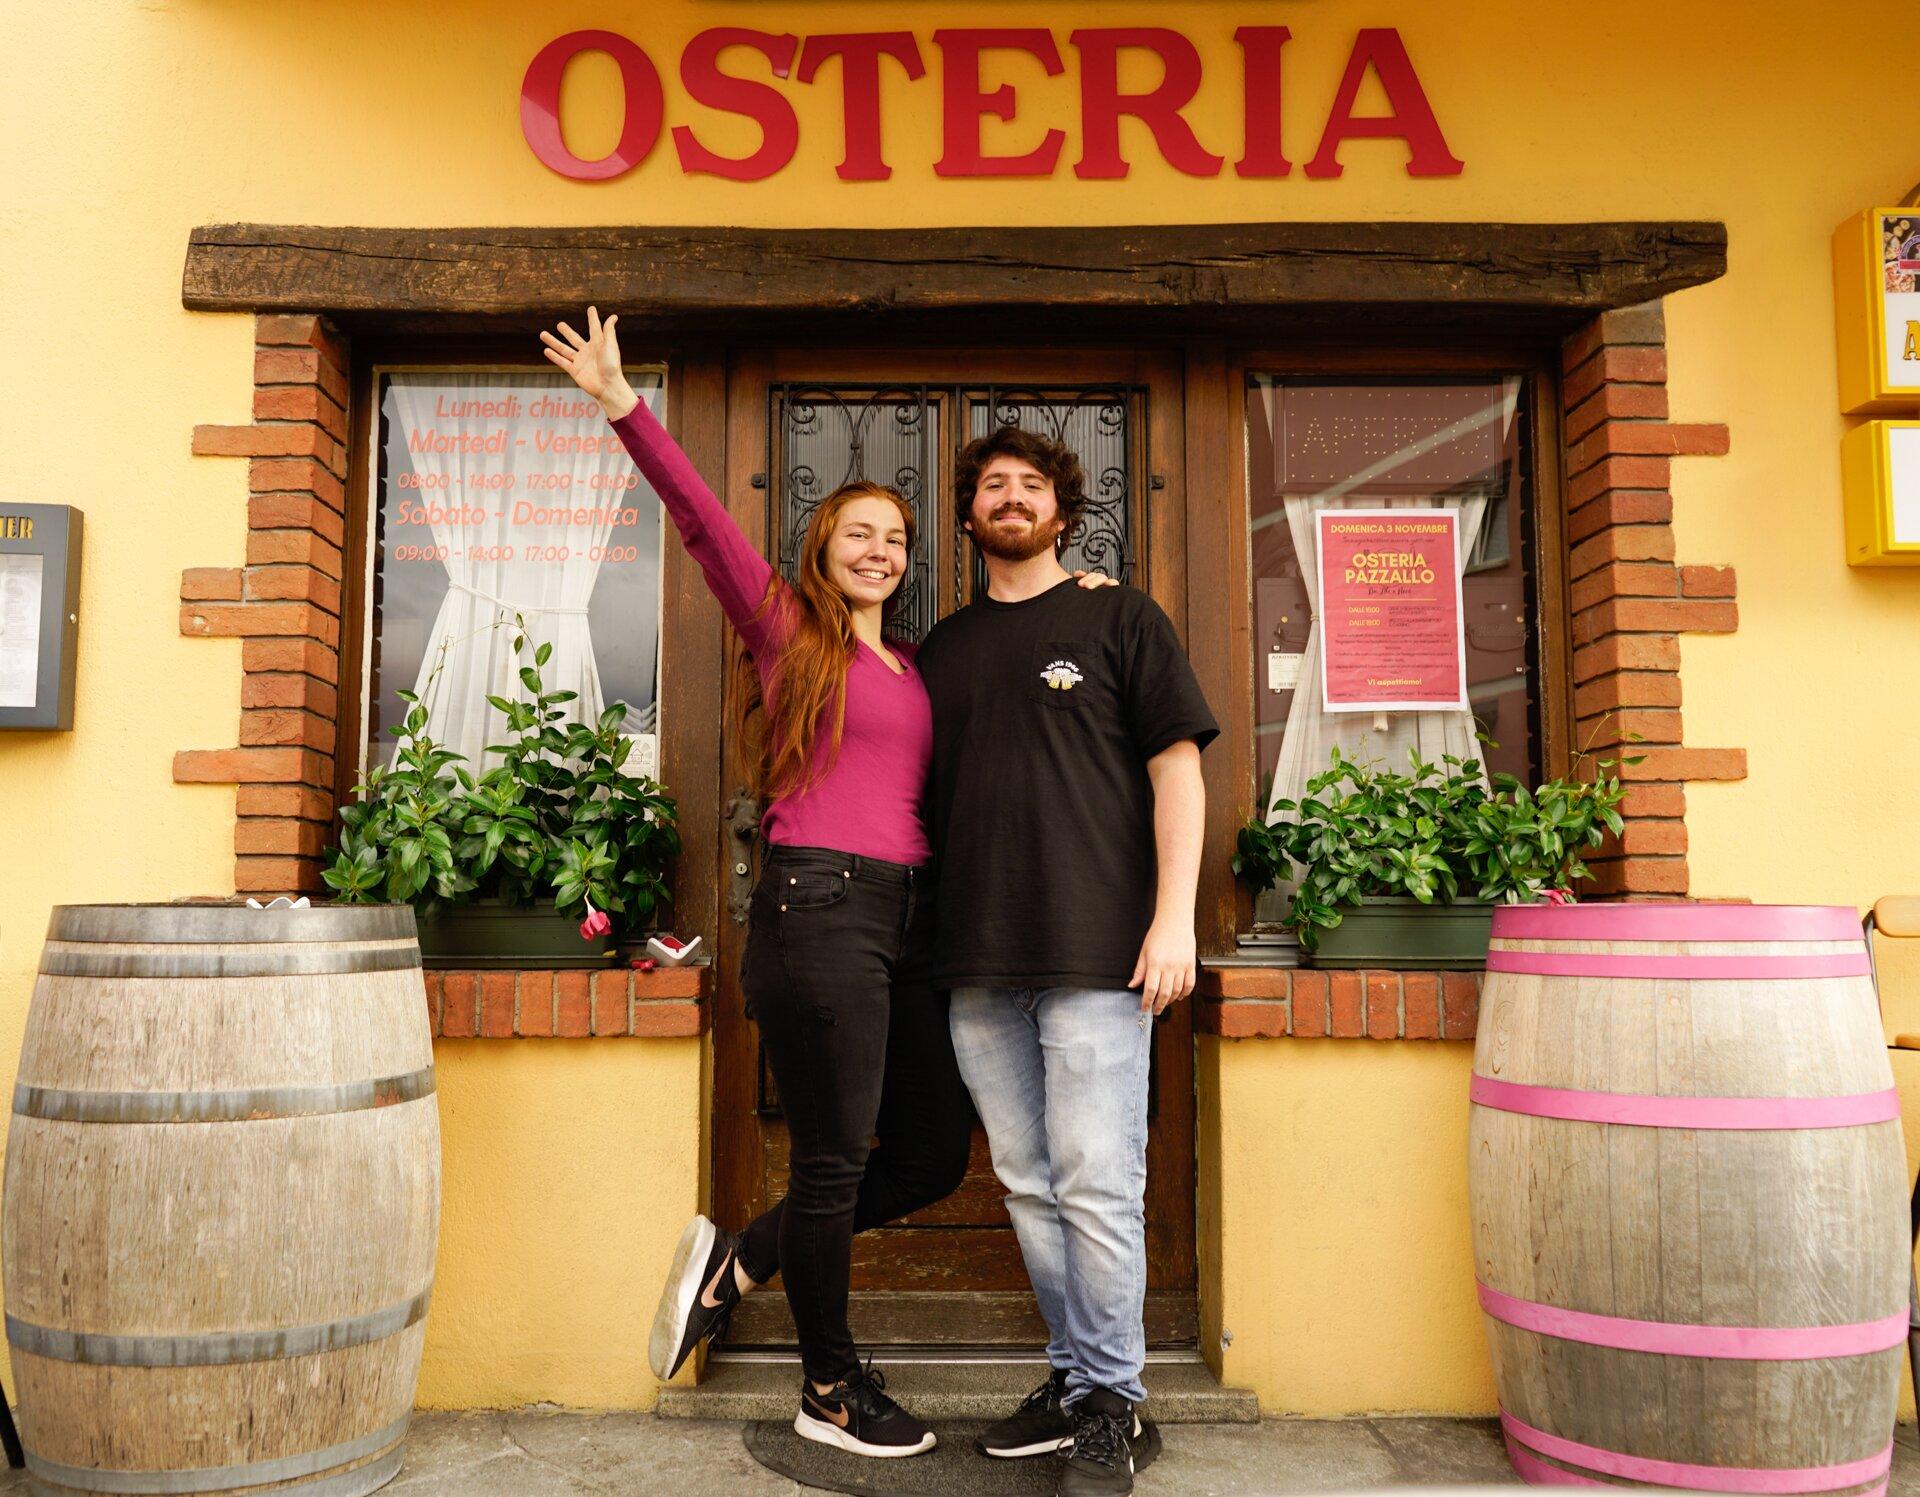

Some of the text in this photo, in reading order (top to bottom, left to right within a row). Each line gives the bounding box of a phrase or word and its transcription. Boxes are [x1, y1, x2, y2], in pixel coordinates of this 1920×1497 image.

[520, 26, 1466, 184] OSTERIA
[528, 396, 600, 419] chiuso
[1302, 417, 1480, 456] APERTO
[397, 473, 450, 490] 08:00
[470, 474, 516, 490] 14:00
[526, 473, 572, 490] 17:00
[590, 473, 639, 490] 01:00
[396, 500, 486, 526] Sabato
[512, 500, 639, 526] Domenica
[1330, 524, 1448, 534] DOMENICA 3 NOVEMBRE
[395, 546, 449, 561] 09:00
[468, 546, 513, 561] 14:00
[523, 546, 570, 561] 17:00
[588, 546, 638, 561] 01:00
[1352, 553, 1427, 568] OSTERIA
[1345, 569, 1435, 584] PAZZALLO
[1046, 660, 1064, 670] VANS
[1367, 678, 1422, 688] Vi aspettiamo!
